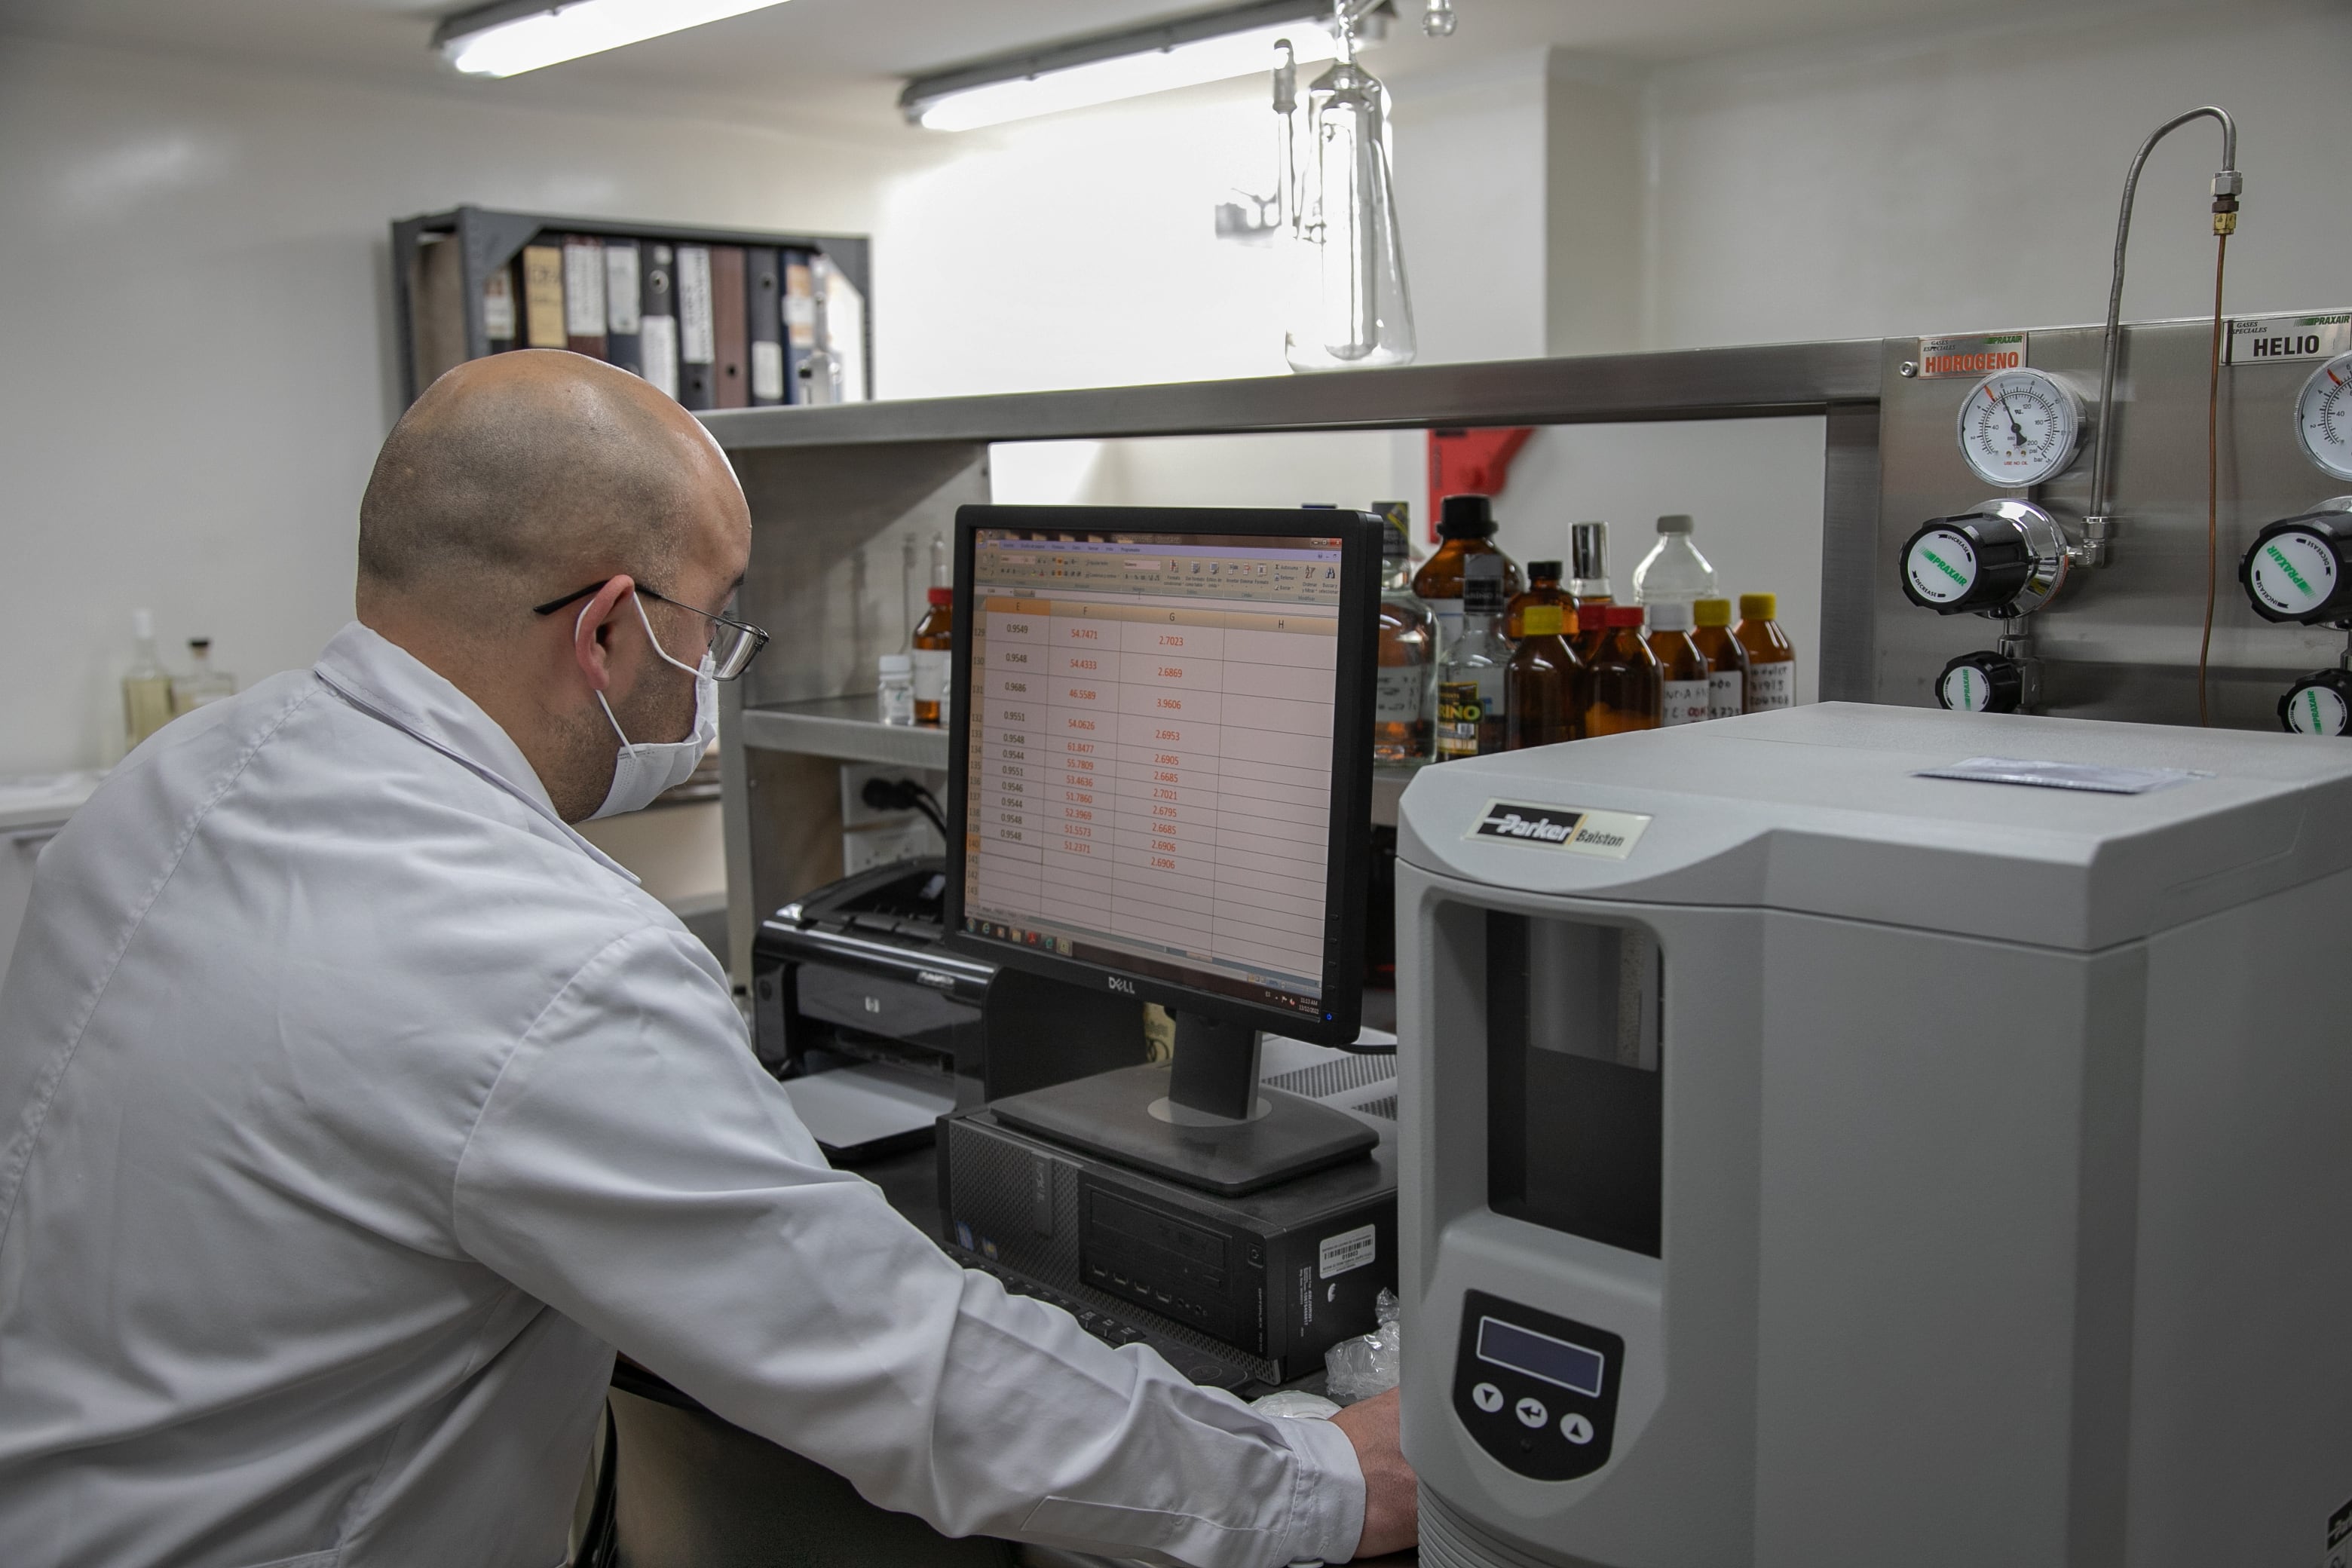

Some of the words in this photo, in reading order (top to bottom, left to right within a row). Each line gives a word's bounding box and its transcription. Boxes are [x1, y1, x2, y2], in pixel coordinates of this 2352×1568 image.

[2314, 315, 2350, 326] PRAXAIR
[1993, 335, 2023, 345] PRAXAIR
[2253, 335, 2320, 357] HELIO
[1925, 351, 2019, 374] HIDROGENO
[1947, 534, 1969, 553] INCREASE
[2307, 541, 2329, 566] DECREASE
[1932, 556, 1968, 587] PRAXAIR
[2266, 545, 2304, 585] PRAXAIR
[1915, 578, 1937, 597] DECREASE
[2256, 581, 2278, 605] INCREASE
[1015, 602, 1021, 611] E
[1083, 606, 1088, 616] F
[1168, 611, 1176, 622] G
[1278, 619, 1285, 629] H
[1006, 623, 1028, 634] 0.9549
[1159, 635, 1184, 646] 2.7023
[1006, 653, 1027, 663] 0.9548
[1158, 666, 1183, 678] 2.6869
[1005, 681, 1027, 693] 0.9686
[1156, 698, 1181, 709] 3.9606
[2307, 691, 2321, 723] PRAXAIR
[1003, 711, 1025, 722] 0.9551
[1155, 729, 1181, 741] 2.6953
[1003, 749, 1024, 761] 0.9544
[1153, 770, 1178, 783] 2.6685
[1154, 754, 1179, 766] 2.6905
[1002, 765, 1024, 777] 0.9551
[1153, 788, 1178, 801] 2.7021
[1001, 797, 1023, 809] 0.9544
[1152, 822, 1177, 835] 2.6685
[1153, 805, 1177, 818] 2.6795
[1484, 813, 1574, 842] Parker
[1576, 828, 1625, 847] Balston
[1151, 840, 1176, 853] 2.6906
[1150, 857, 1175, 869] 2.6906
[1108, 976, 1135, 994] DELL
